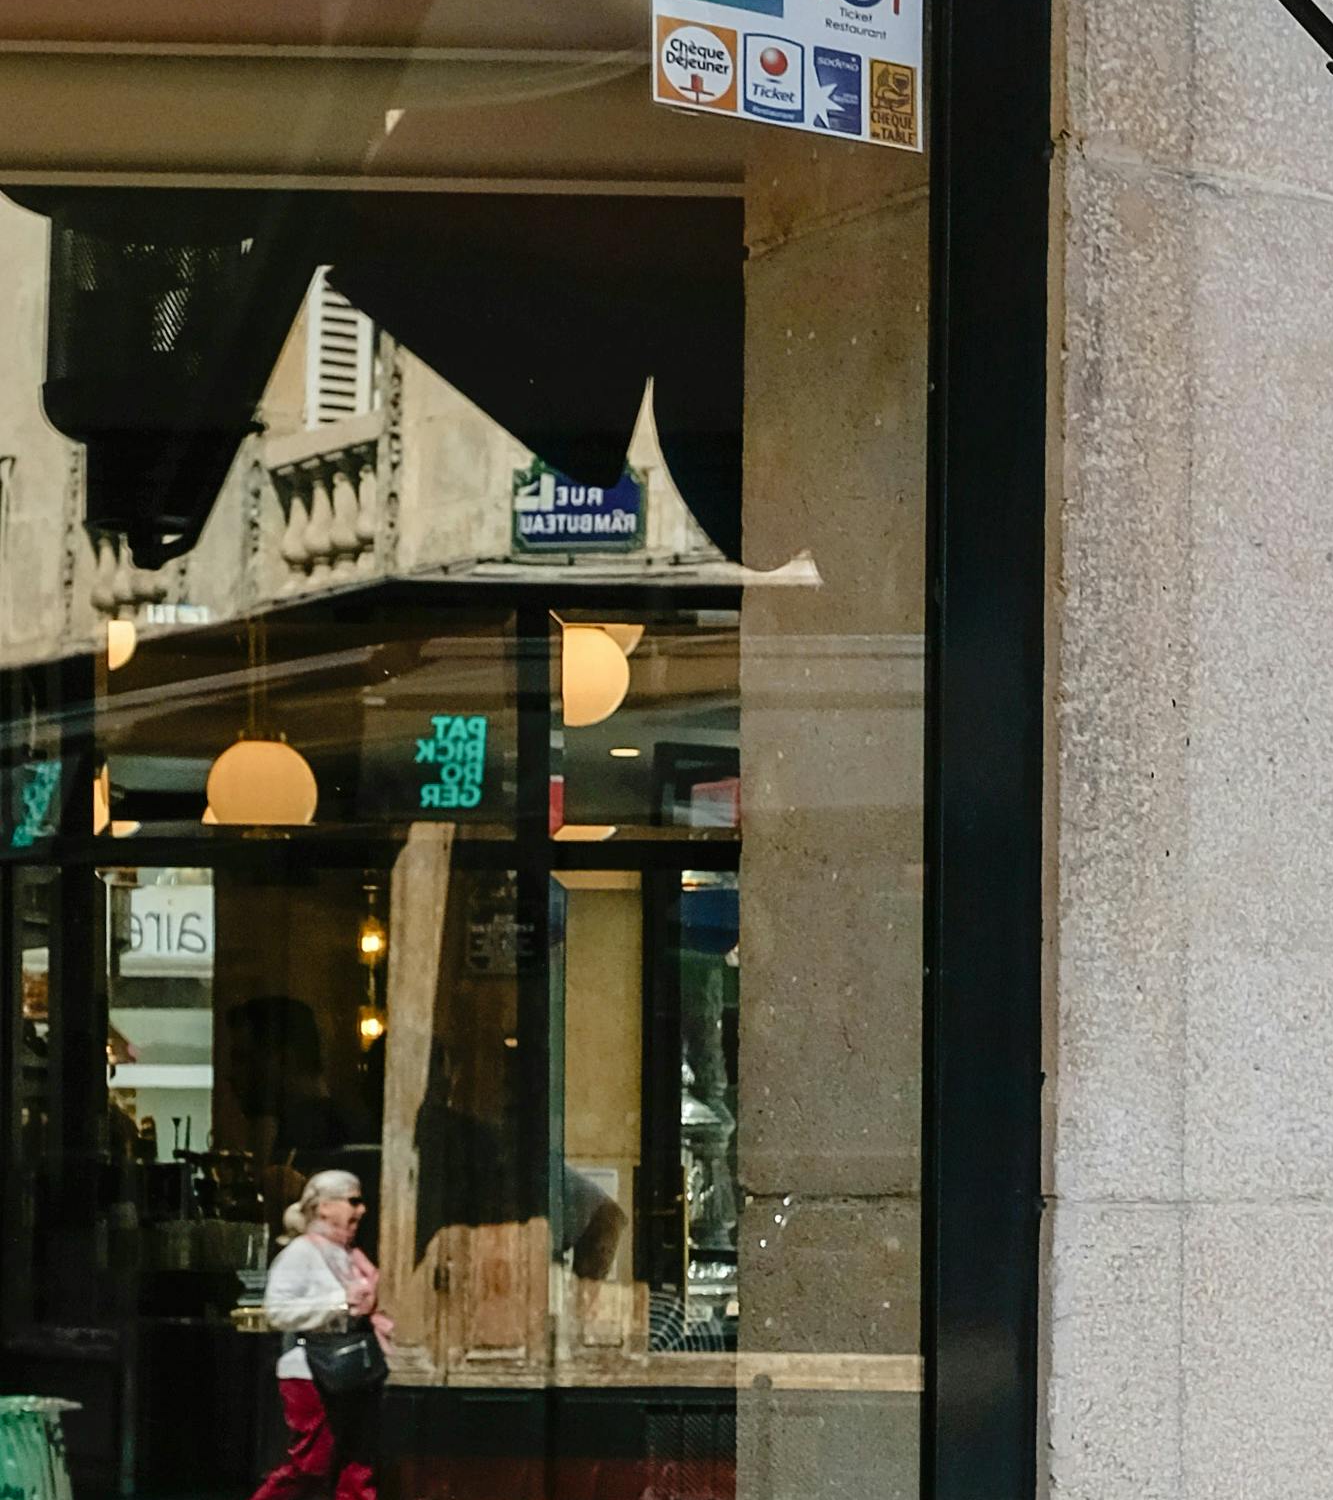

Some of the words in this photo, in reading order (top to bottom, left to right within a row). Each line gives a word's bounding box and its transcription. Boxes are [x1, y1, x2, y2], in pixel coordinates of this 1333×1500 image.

[839, 6, 874, 23] Ticket
[825, 18, 888, 41] Restaurant
[670, 38, 725, 62] Chèque
[751, 82, 796, 104] Ticket
[881, 128, 915, 146] TABLE
